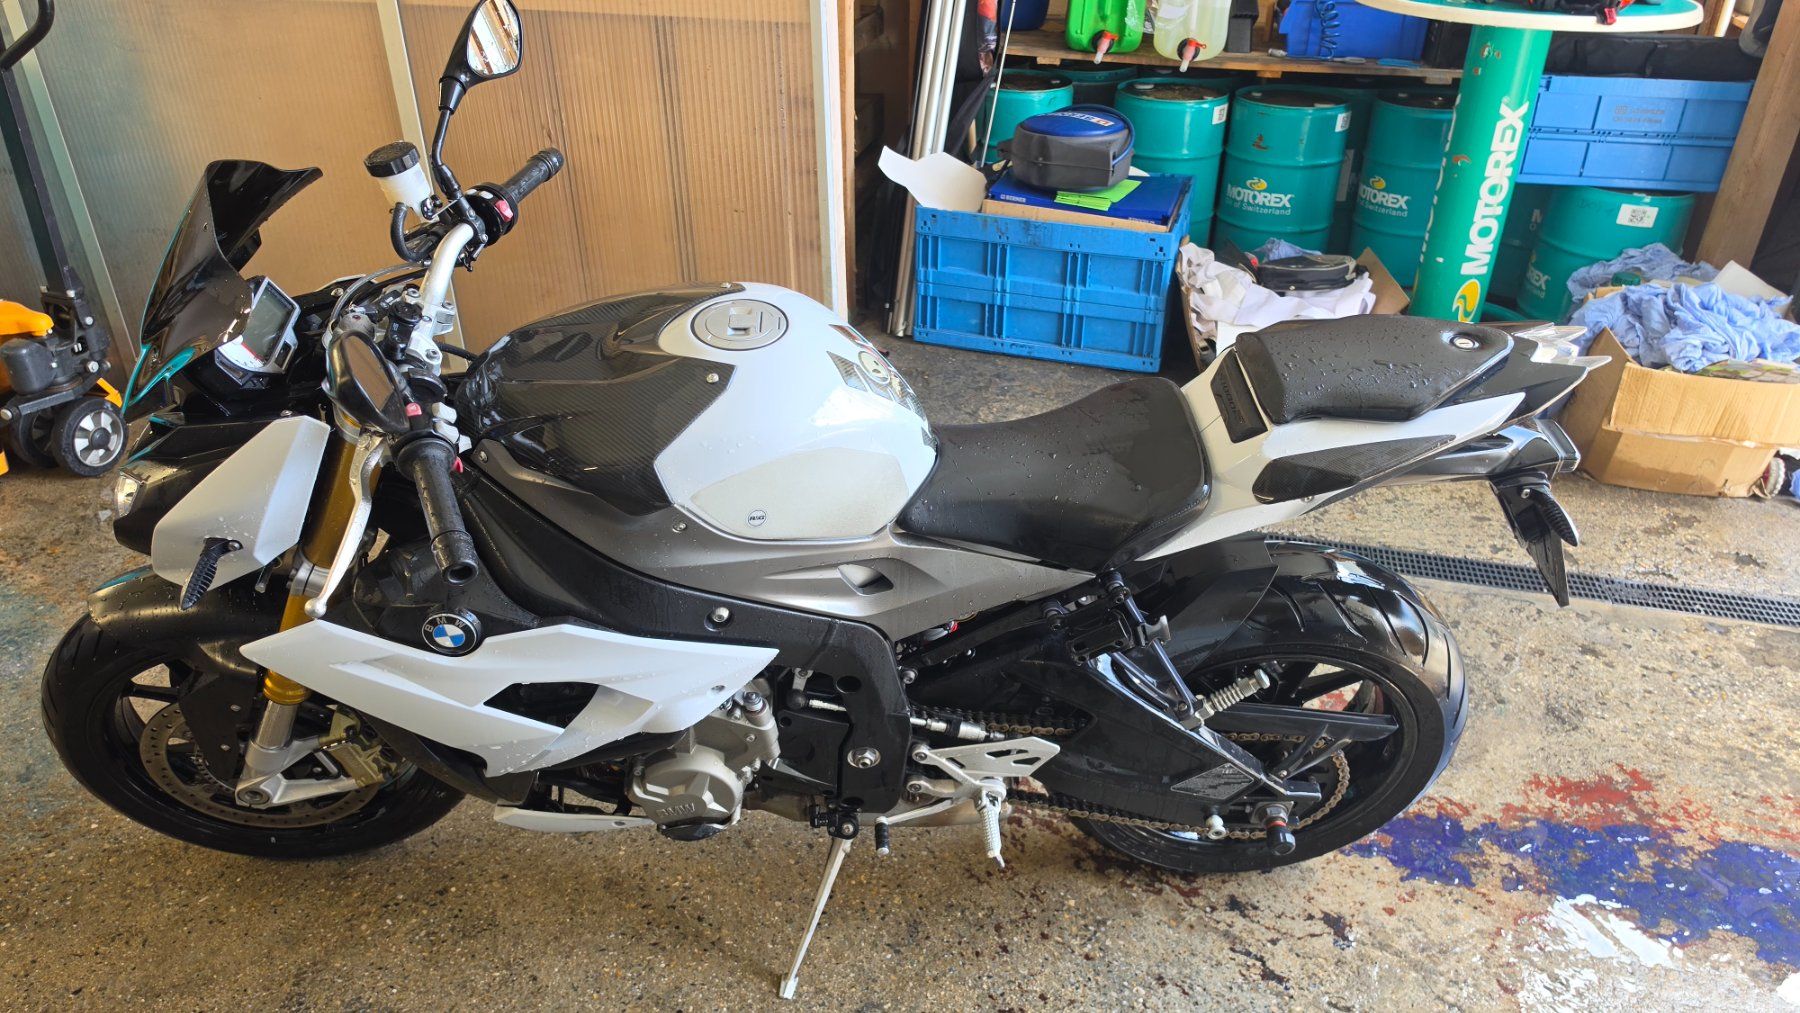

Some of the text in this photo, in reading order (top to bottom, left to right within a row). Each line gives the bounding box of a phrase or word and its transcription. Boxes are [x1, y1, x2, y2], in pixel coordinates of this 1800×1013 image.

[1226, 183, 1294, 208] MOTOREX
[1359, 184, 1409, 211] OTOREX
[1460, 101, 1530, 275] MOTOREX
[1242, 203, 1291, 216] Switzerland
[424, 616, 466, 632] BMW
